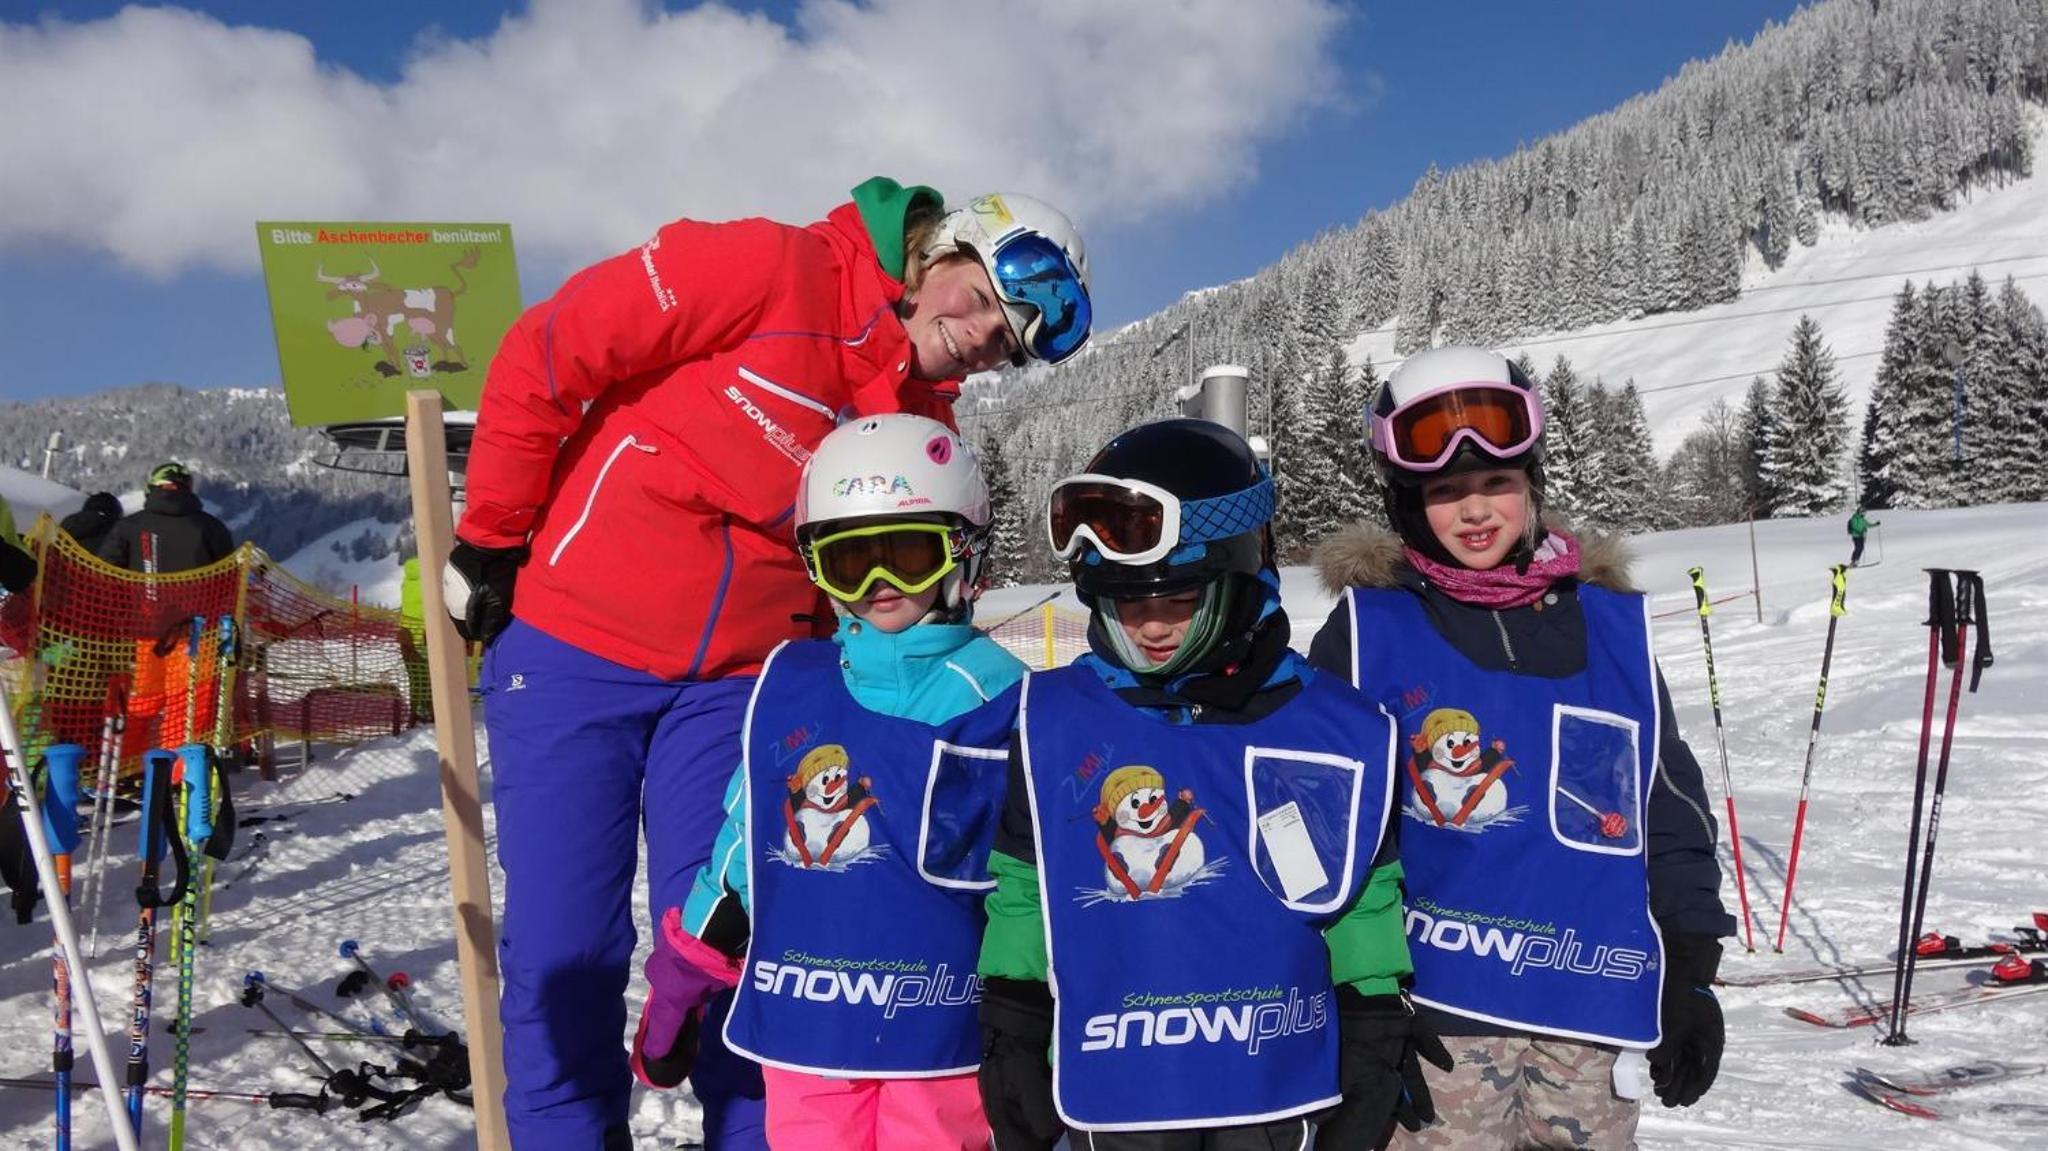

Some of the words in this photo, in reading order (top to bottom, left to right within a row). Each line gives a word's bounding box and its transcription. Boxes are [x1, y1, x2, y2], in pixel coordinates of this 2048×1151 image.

[272, 229, 313, 245] Bitte
[317, 229, 430, 245] Aschenbecher
[432, 230, 502, 245] benützen!
[1413, 896, 1558, 936] Schneesportschule
[1402, 905, 1649, 980] nowplus
[782, 949, 928, 973] Schneesportschule
[1122, 984, 1285, 1009] Schneesportschule
